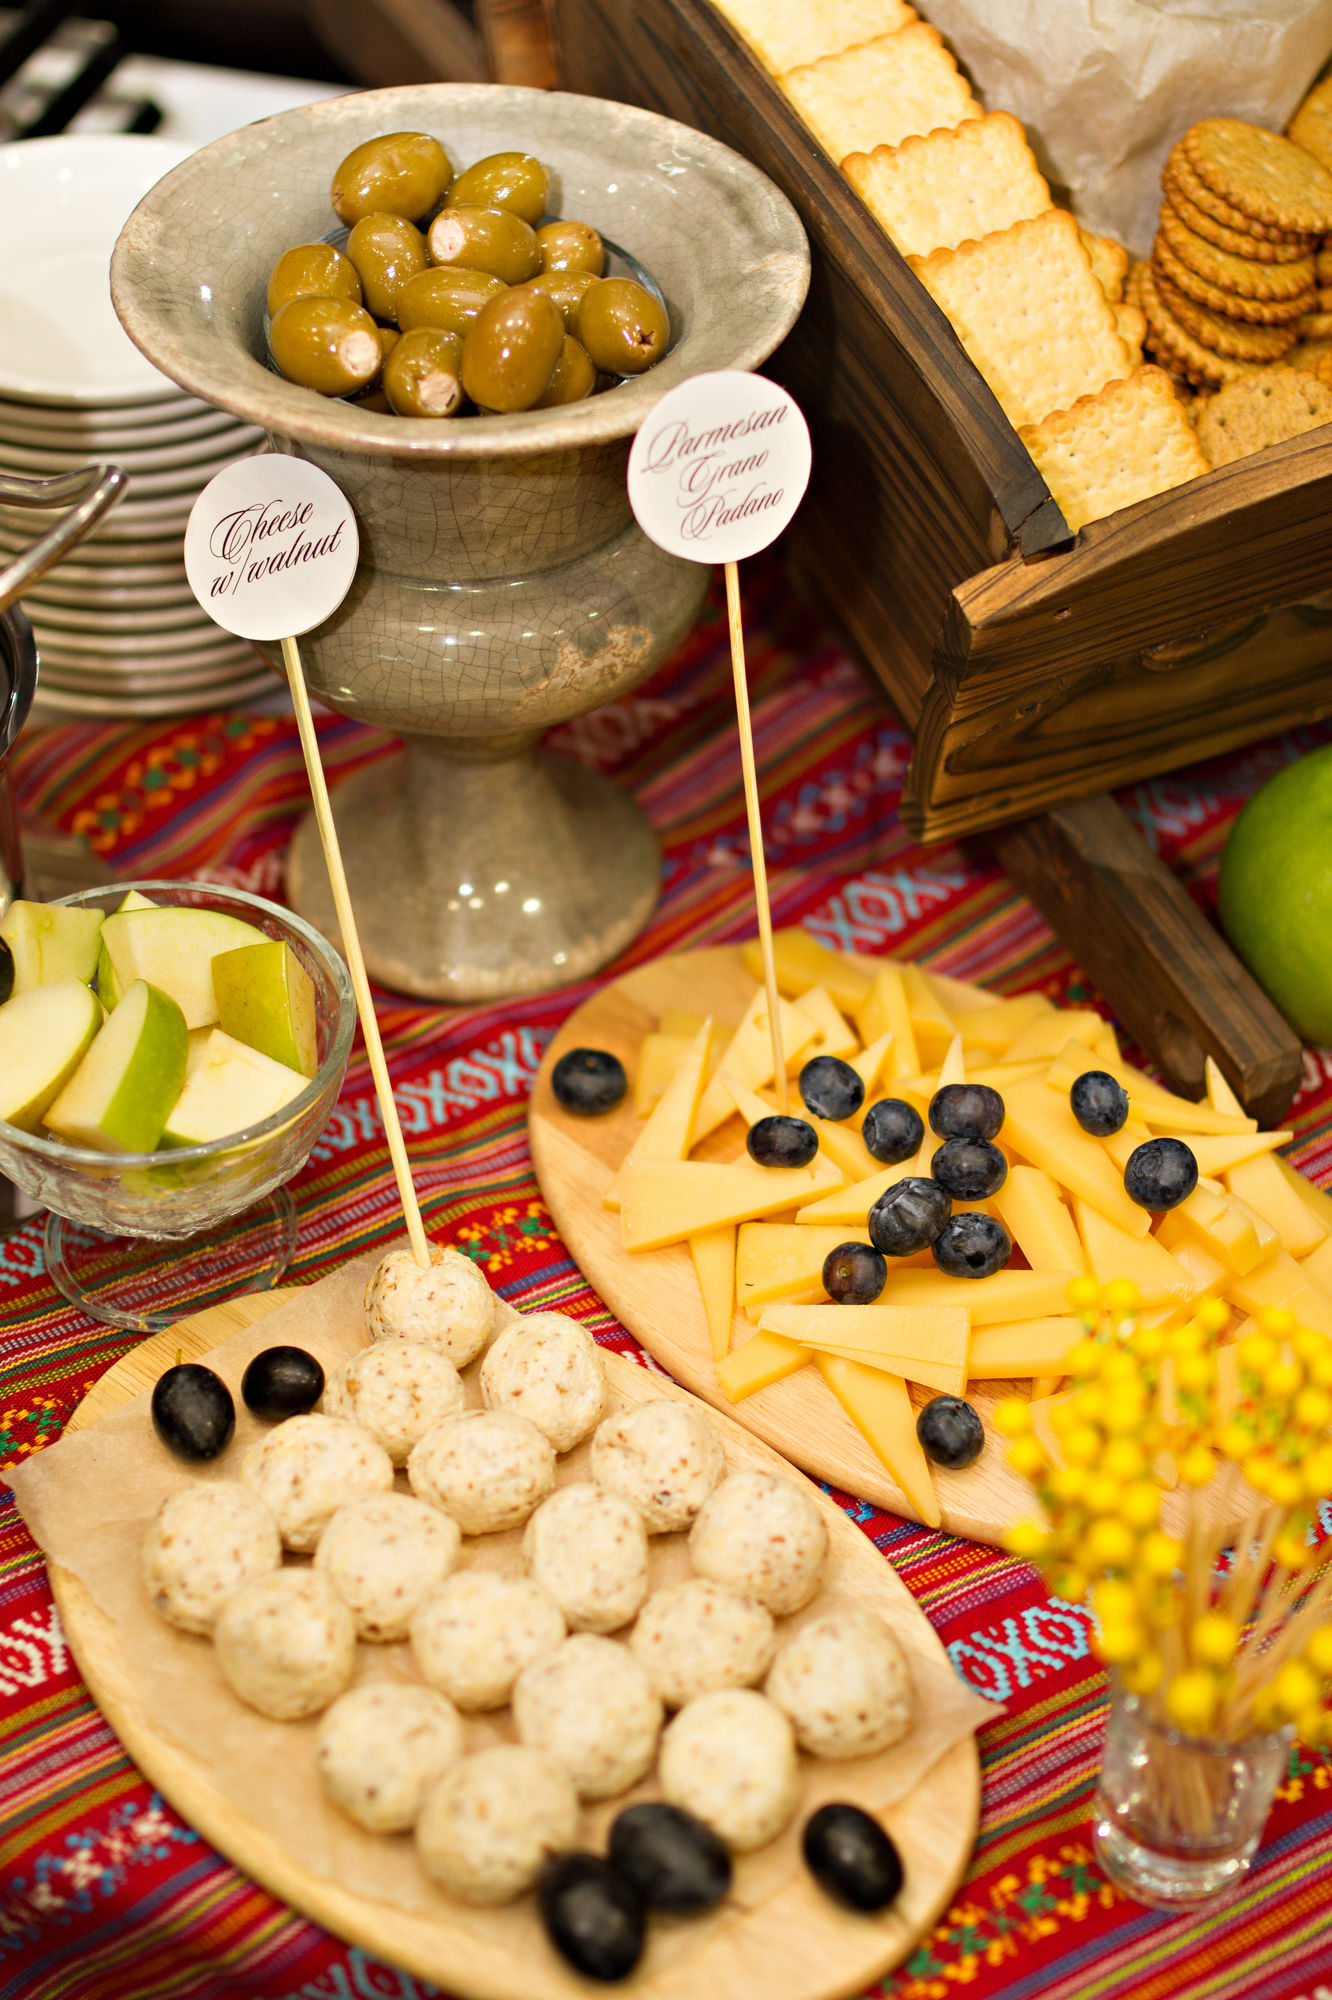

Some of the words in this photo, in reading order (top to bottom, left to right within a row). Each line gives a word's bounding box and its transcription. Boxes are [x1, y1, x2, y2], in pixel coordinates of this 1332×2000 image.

[641, 405, 787, 474] Parmesan
[677, 450, 769, 508] Grano
[680, 482, 784, 541] Padano
[210, 499, 314, 564] Cheese
[210, 520, 346, 597] w/walnut
